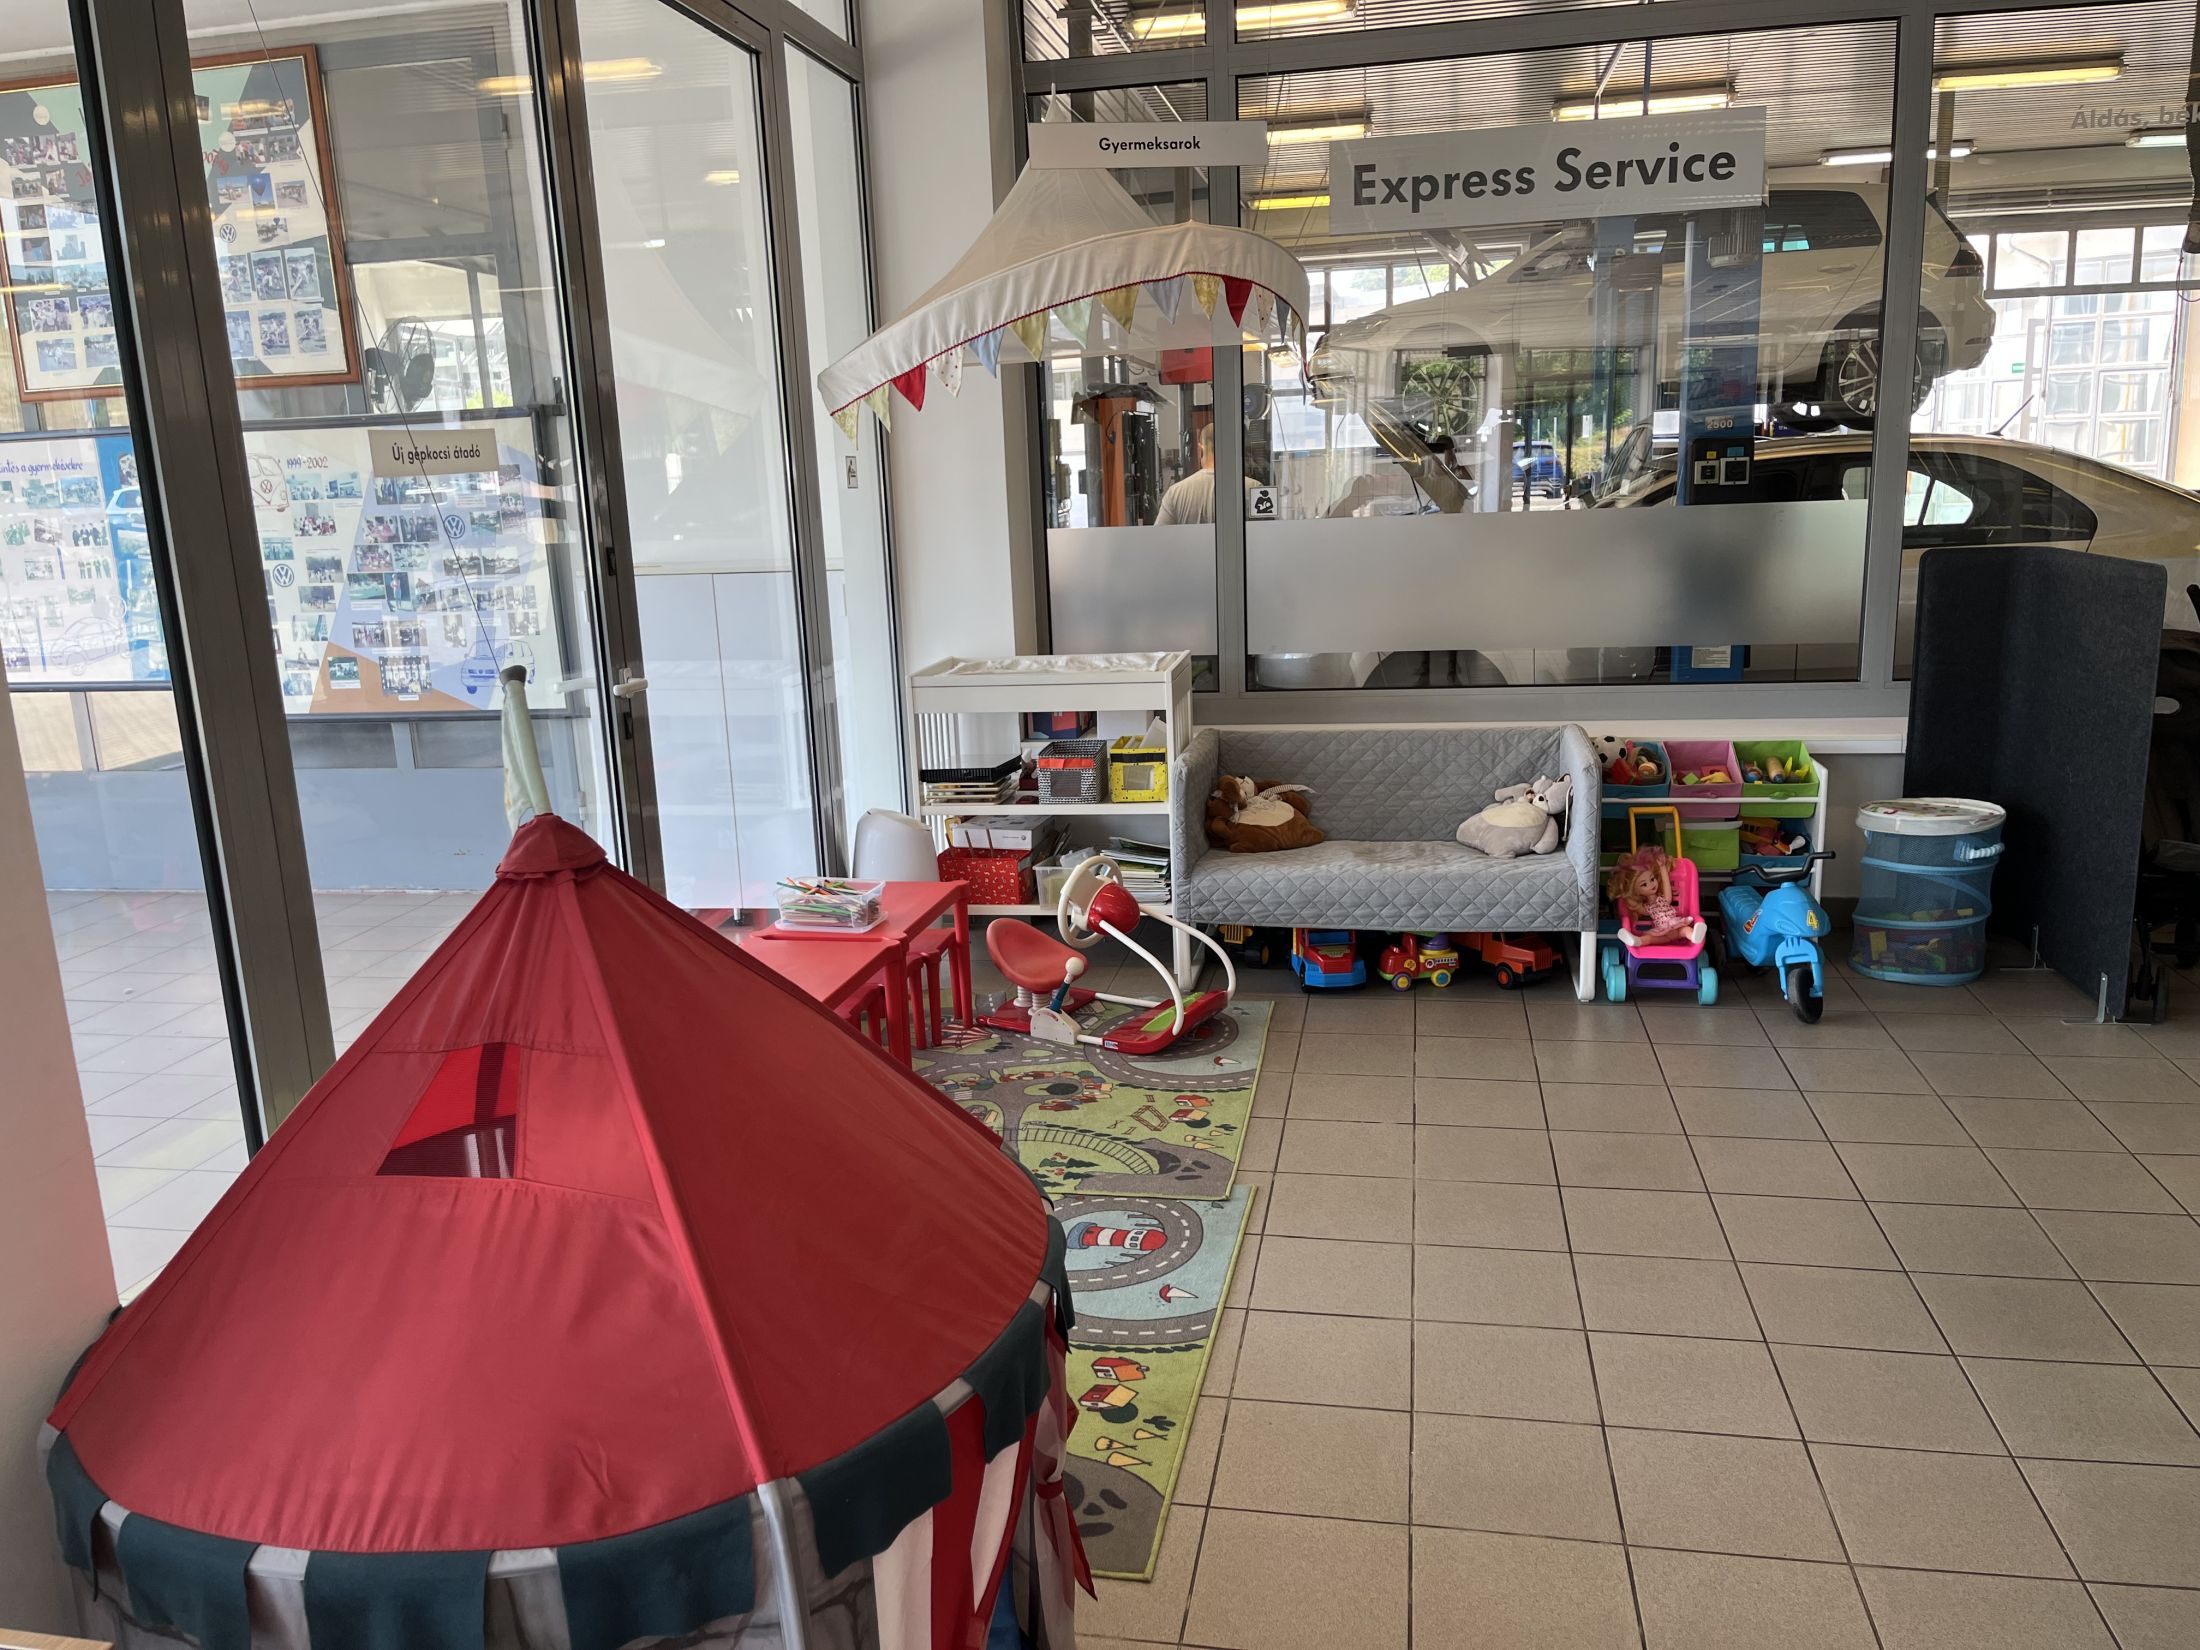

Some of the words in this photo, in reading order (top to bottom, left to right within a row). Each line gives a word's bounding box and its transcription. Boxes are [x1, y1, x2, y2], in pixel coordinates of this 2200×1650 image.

[2071, 104, 2149, 129] Áldás,
[1099, 135, 1201, 154] Gyermeksarok
[1353, 163, 1536, 214] Express
[1553, 141, 1737, 193] Service
[1706, 419, 1734, 430] 2500
[392, 442, 405, 465] Új
[407, 444, 451, 465] gépkocsi
[453, 443, 481, 460] átadó
[1806, 909, 1819, 930] 4
